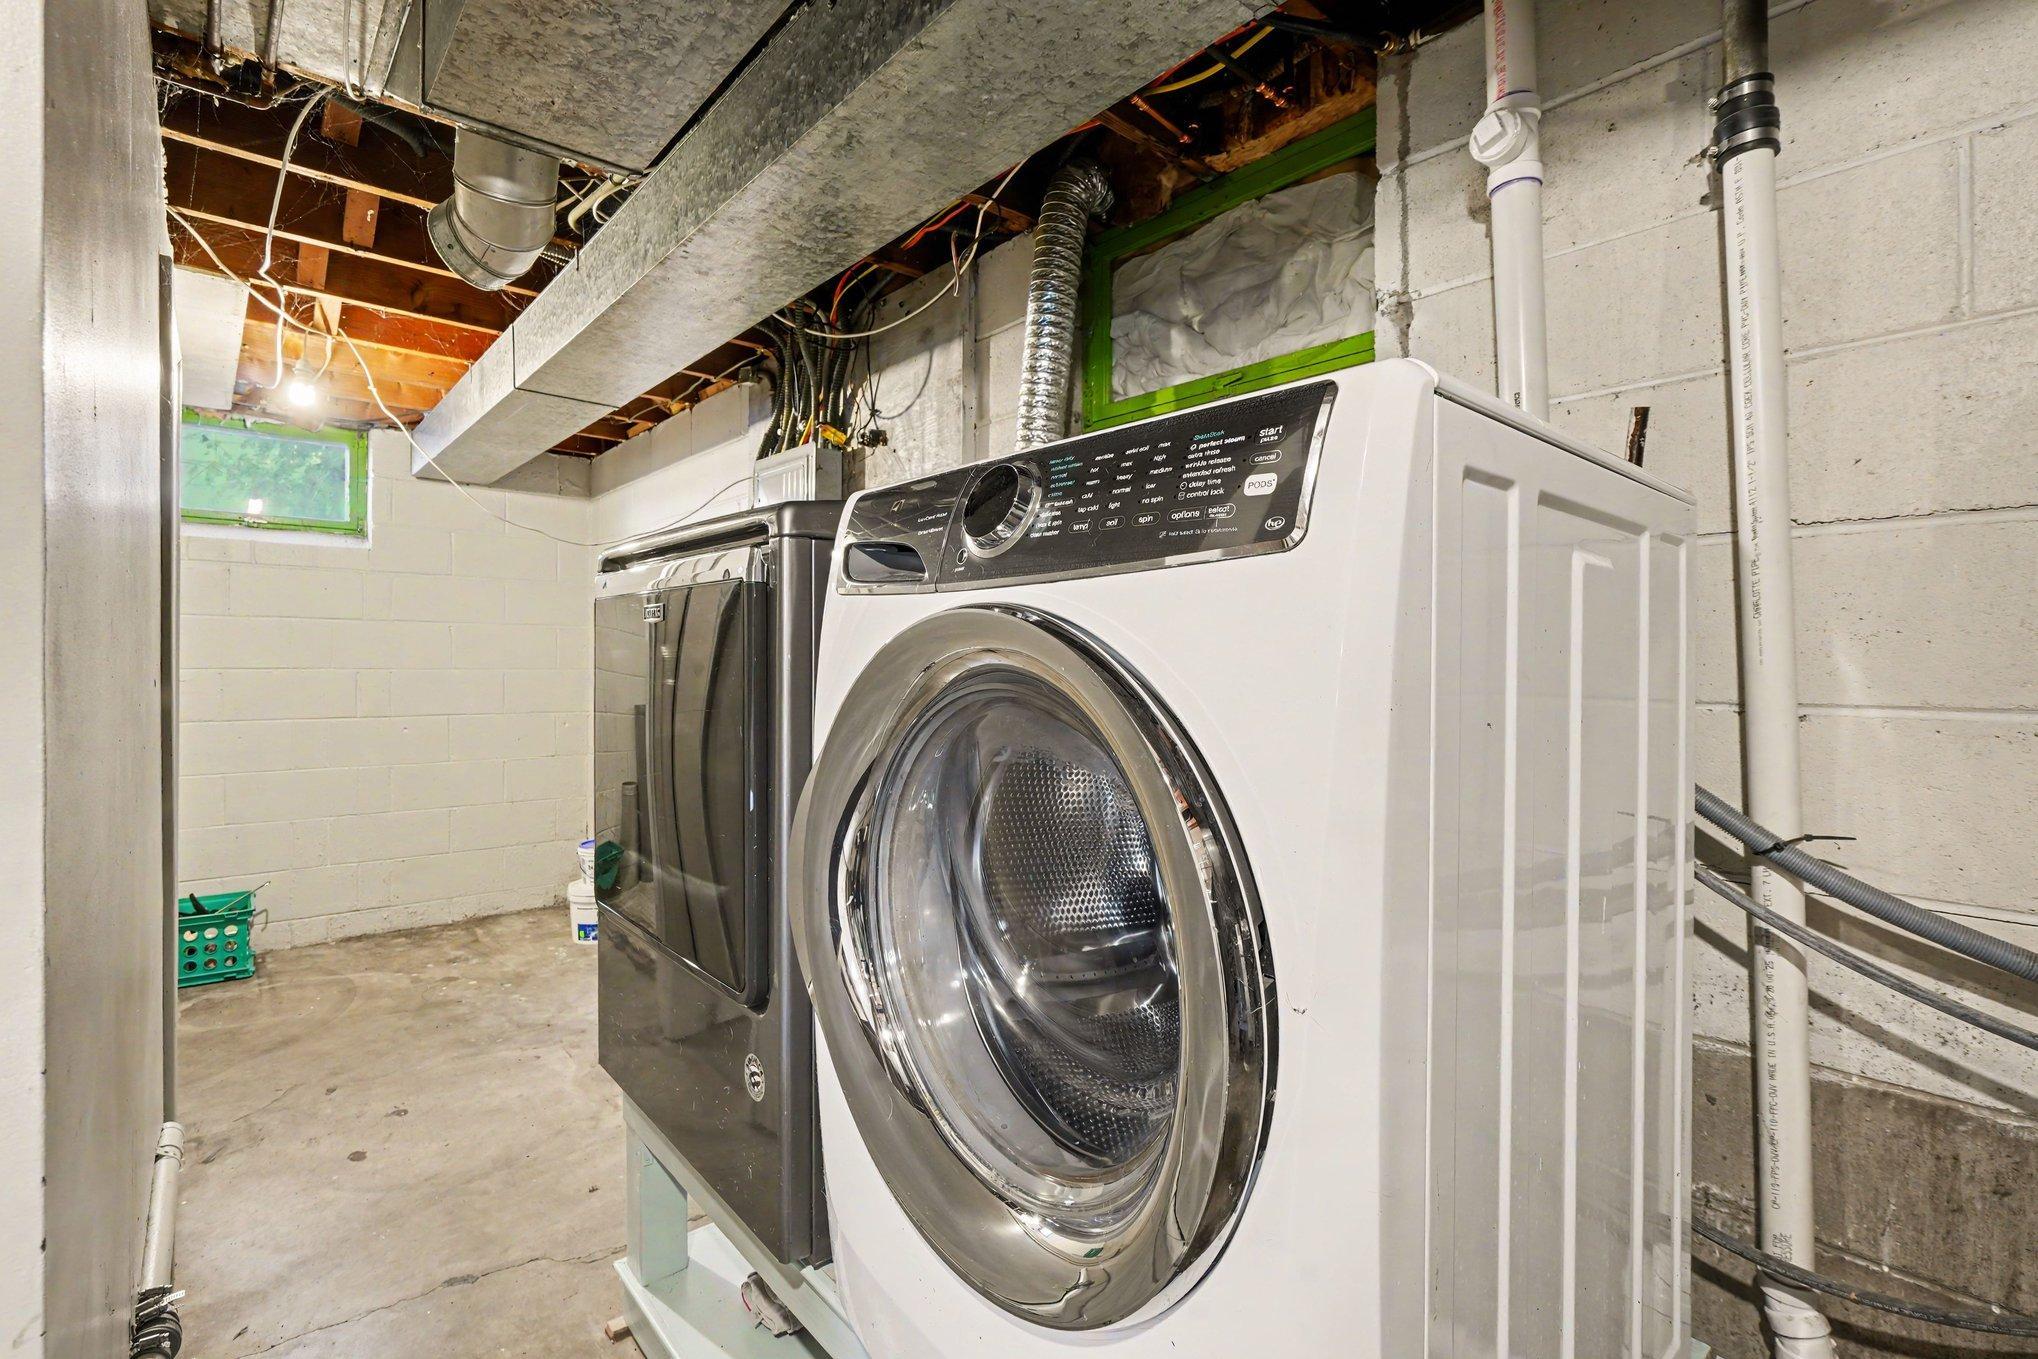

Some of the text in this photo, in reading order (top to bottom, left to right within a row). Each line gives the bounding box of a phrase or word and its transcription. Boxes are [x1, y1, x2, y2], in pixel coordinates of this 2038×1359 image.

[1259, 425, 1283, 437] start
[1198, 435, 1246, 450] perfect steam
[1185, 457, 1231, 469] wrinkle release
[1254, 454, 1277, 463] cancel
[1149, 467, 1173, 475] medium
[1182, 465, 1236, 479] extended refresh
[1188, 478, 1222, 489] delay time
[1112, 486, 1132, 494] normal
[1186, 487, 1225, 499] control lock
[1150, 495, 1164, 504] spin
[1138, 515, 1153, 524] spin
[1171, 510, 1200, 520] options
[1106, 519, 1118, 527] soil
[1753, 578, 1761, 620] CHARLOTTE
[1768, 1062, 1777, 1081] MADE
